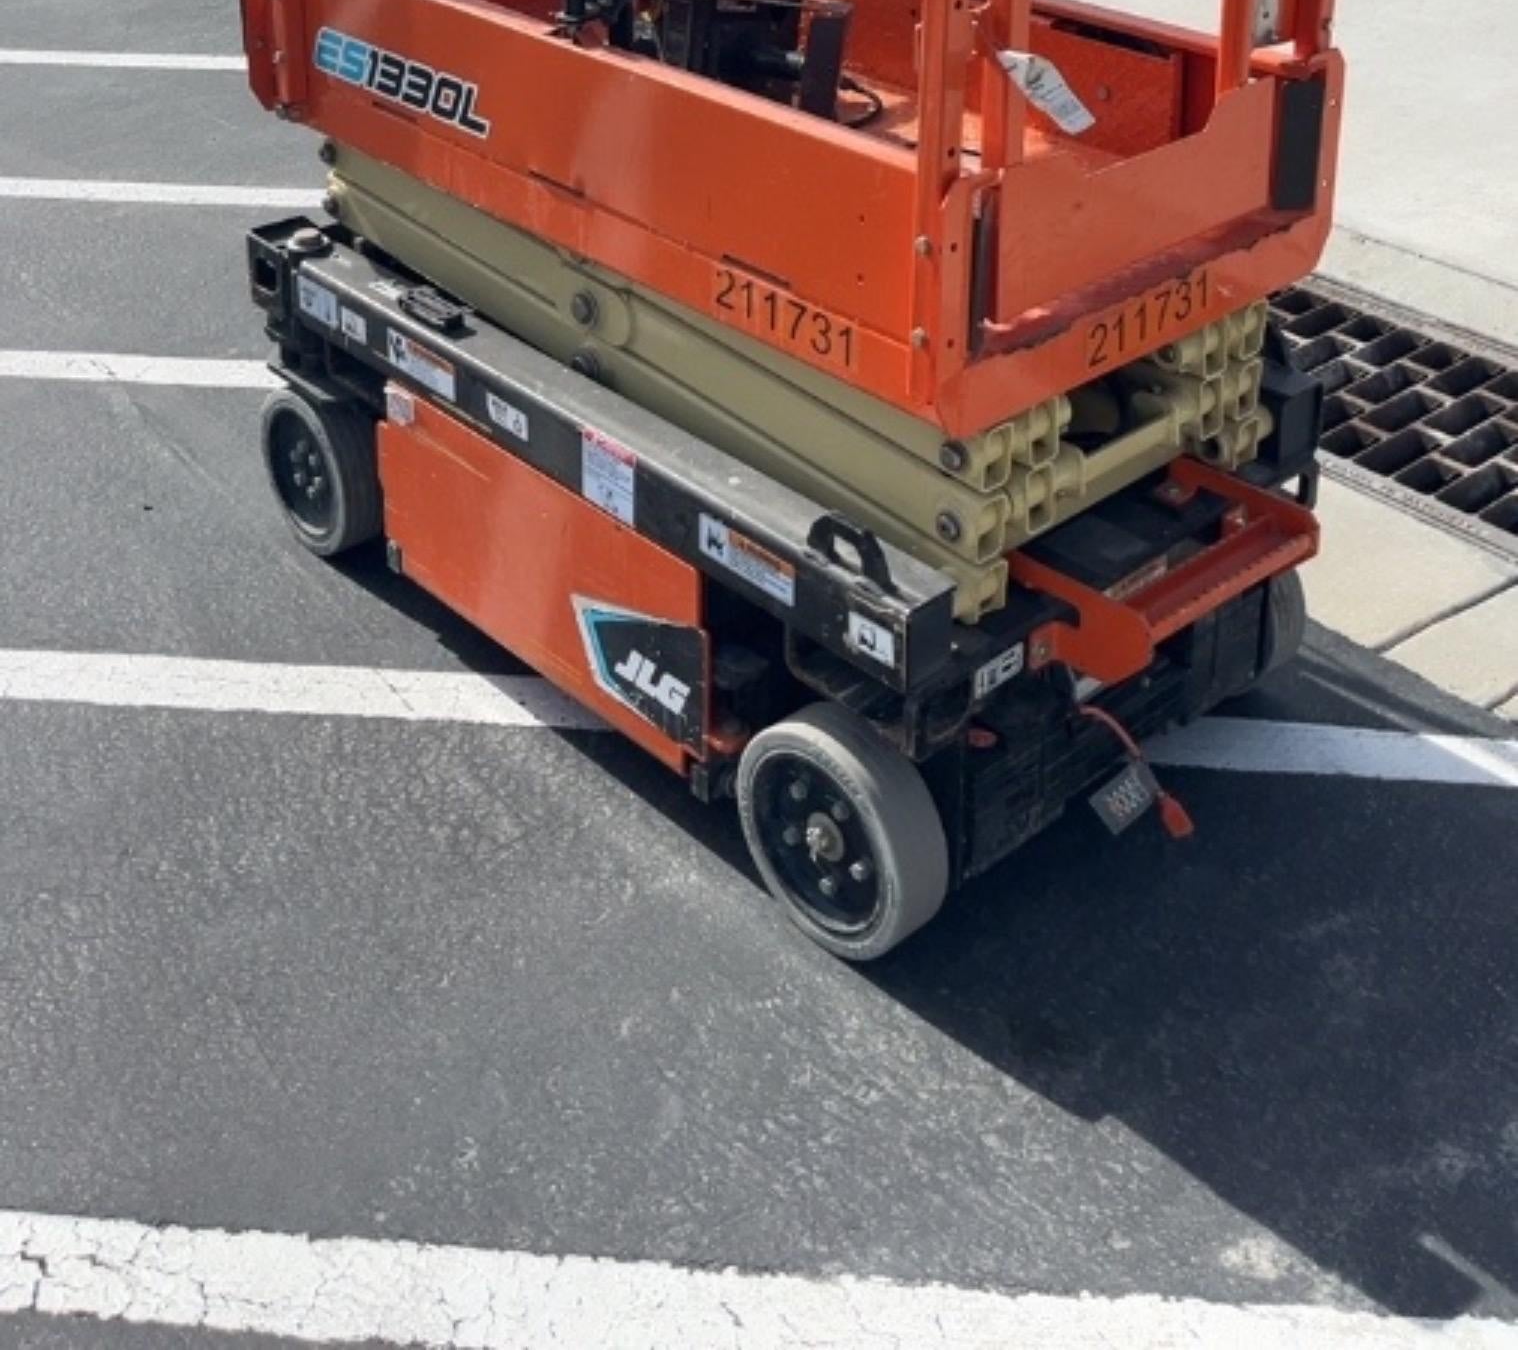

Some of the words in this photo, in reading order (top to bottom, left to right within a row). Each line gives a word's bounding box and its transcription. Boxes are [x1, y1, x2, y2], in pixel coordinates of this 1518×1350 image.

[314, 27, 490, 139] ES1330L
[715, 269, 854, 368] 211731
[1087, 269, 1209, 369] 211731
[613, 648, 692, 716] JLG
